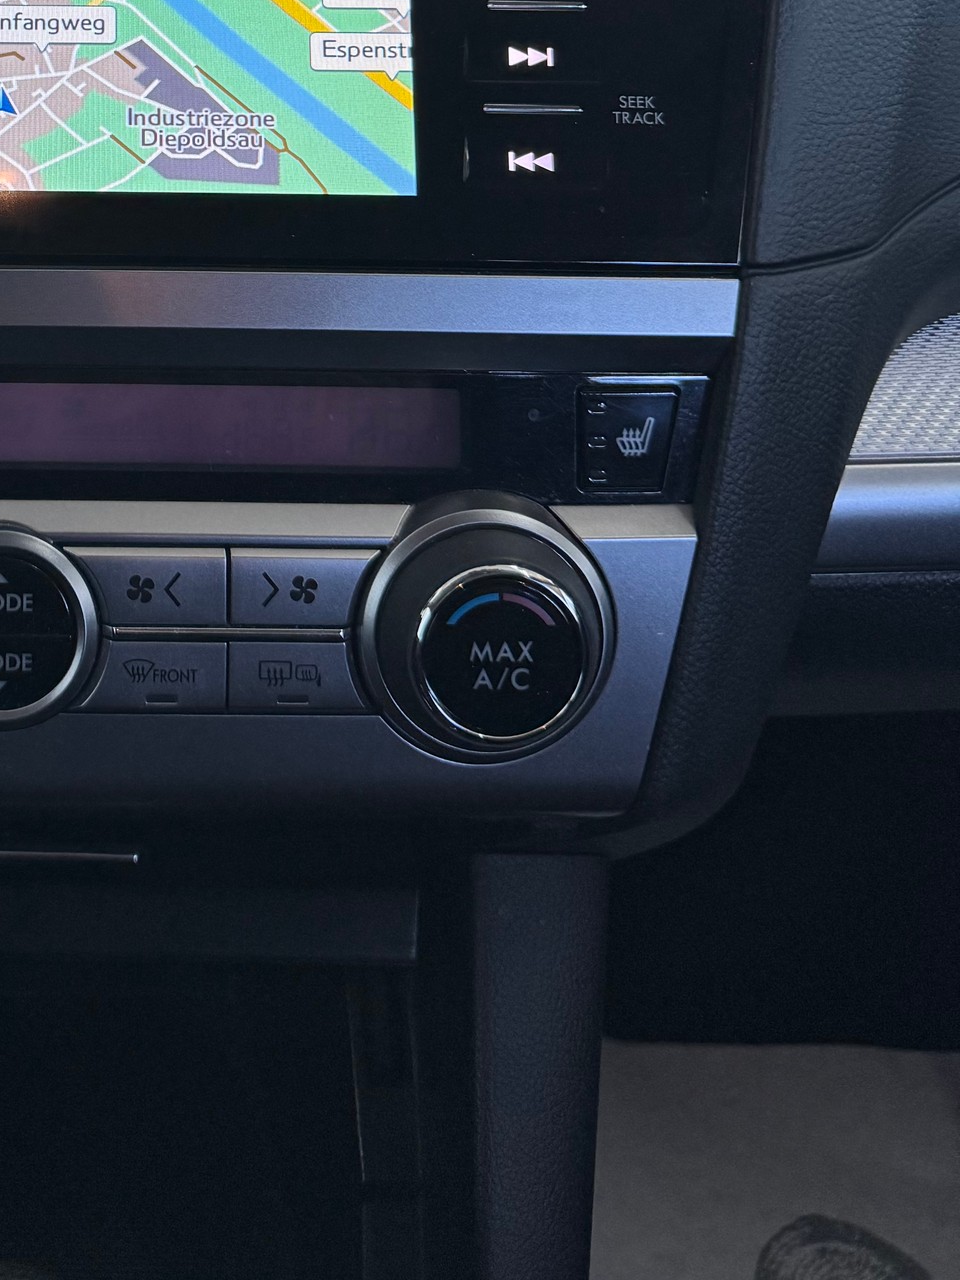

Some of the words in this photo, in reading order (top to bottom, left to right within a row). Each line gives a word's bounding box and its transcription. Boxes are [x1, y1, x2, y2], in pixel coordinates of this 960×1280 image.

[619, 96, 655, 109] SEEK
[128, 110, 275, 127] Industriezone
[613, 111, 664, 125] TRACK
[141, 130, 263, 149] Diepoldsau
[469, 641, 534, 663] MAX
[152, 667, 196, 685] FRONT
[472, 666, 530, 692] A/C
